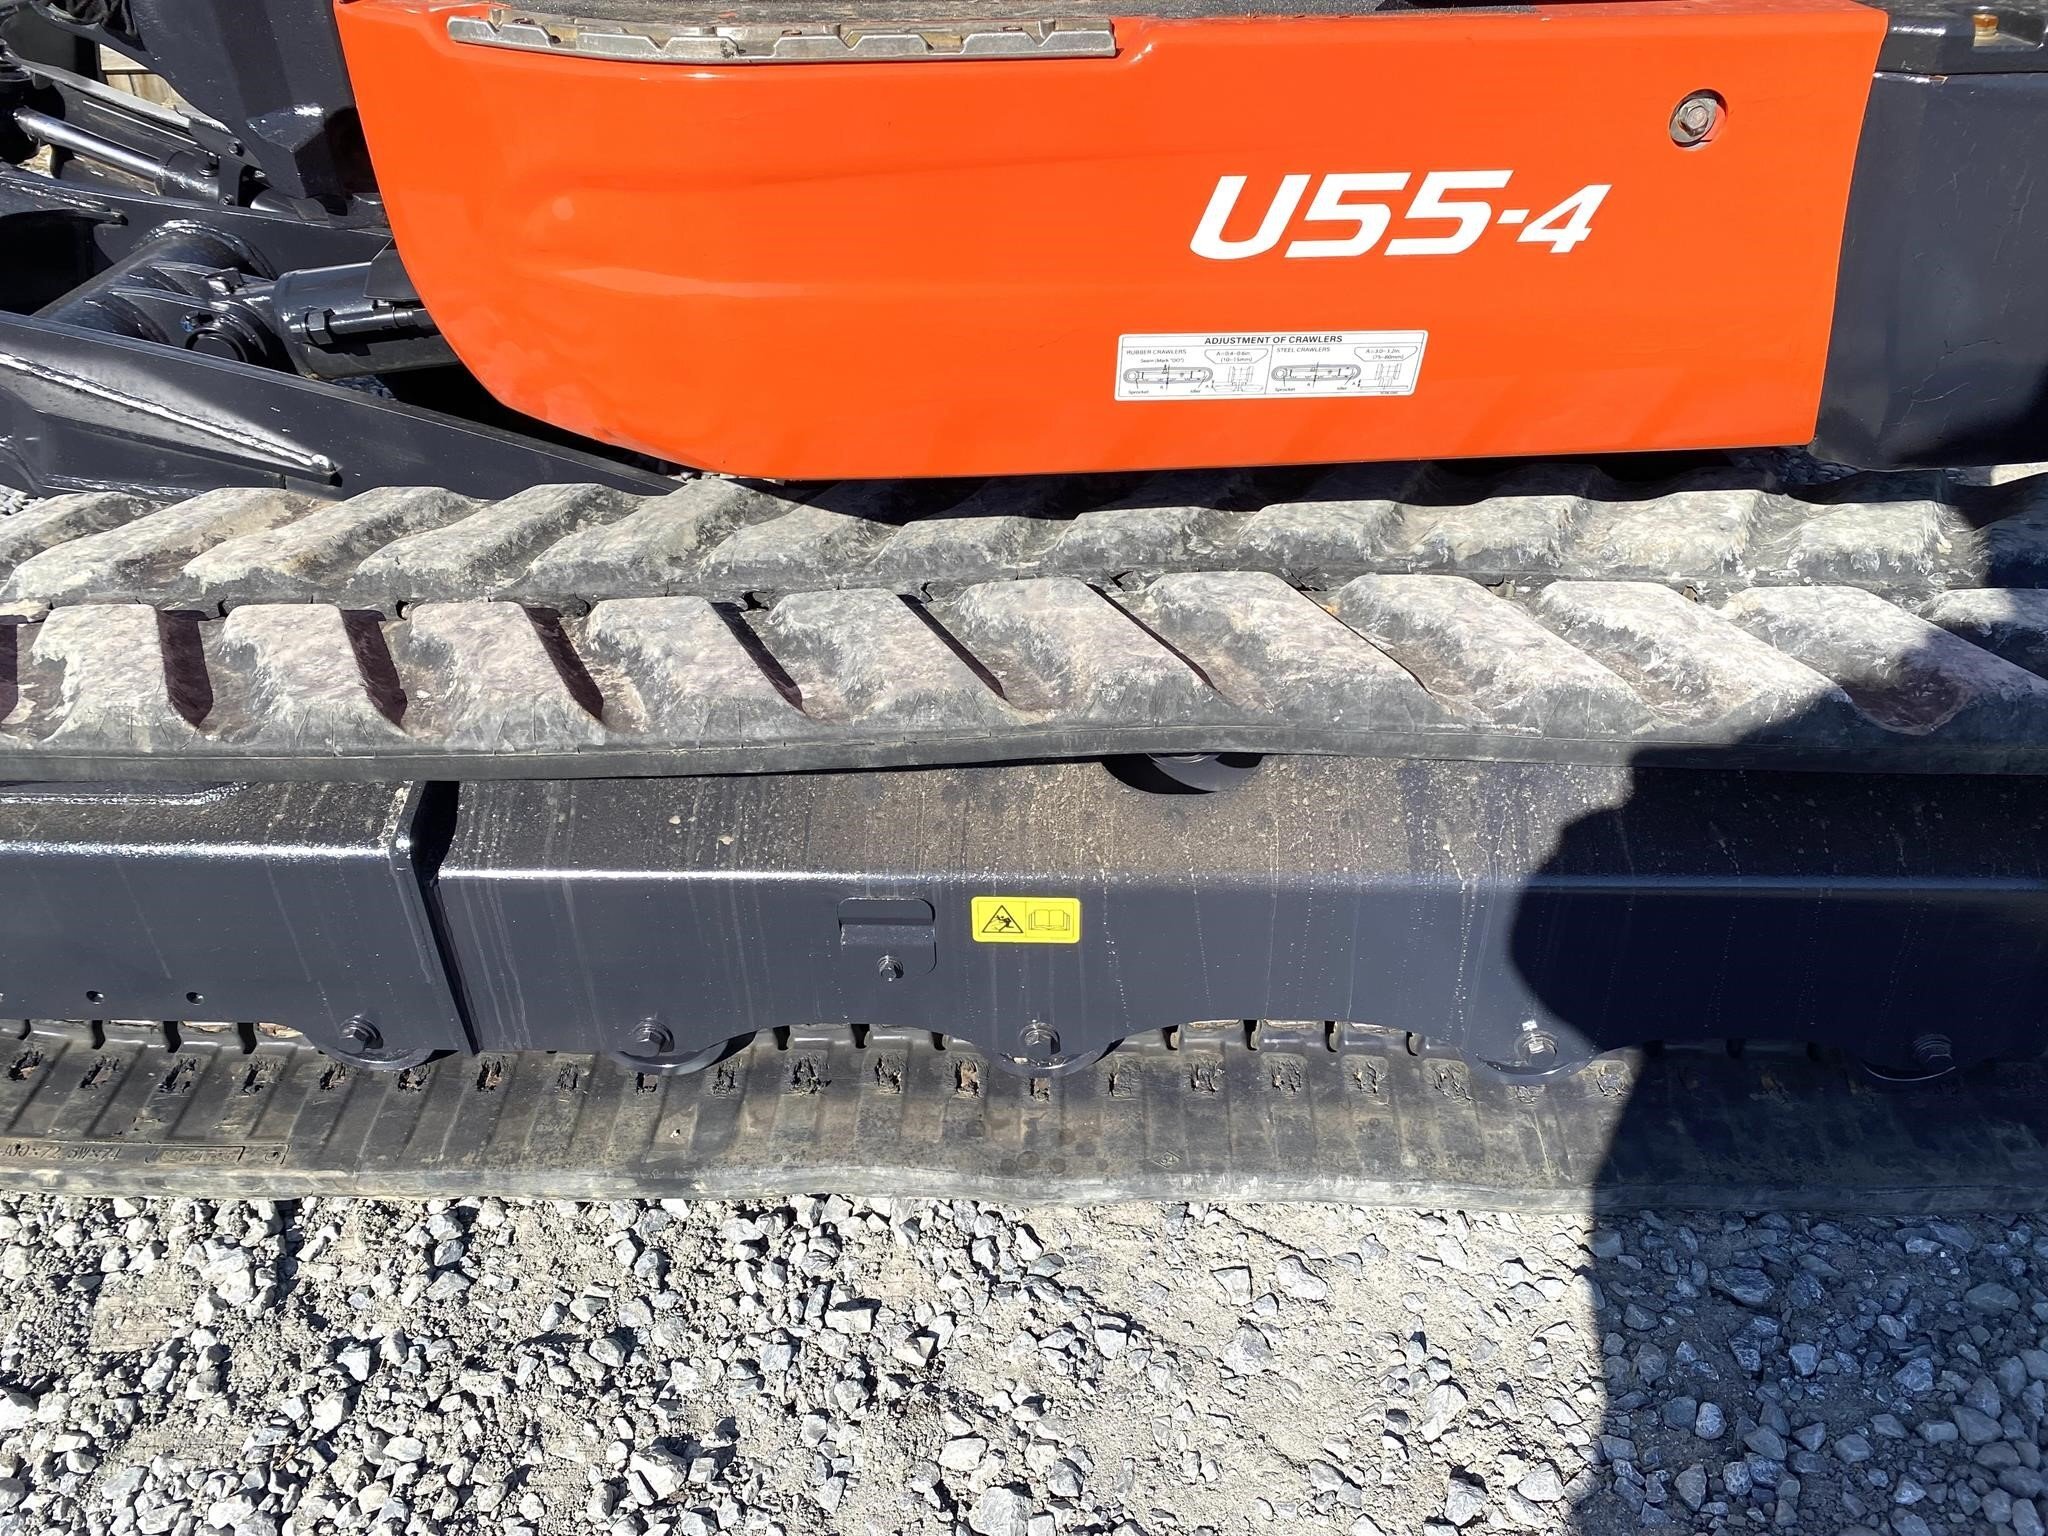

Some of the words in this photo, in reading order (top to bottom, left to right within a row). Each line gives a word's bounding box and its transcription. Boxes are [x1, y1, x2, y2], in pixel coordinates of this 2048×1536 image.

[1189, 169, 1612, 260] U55-4
[1204, 336, 1271, 345] ADJUSTMENT
[1272, 336, 1287, 344] OF
[1288, 335, 1343, 343] CRAWLERS
